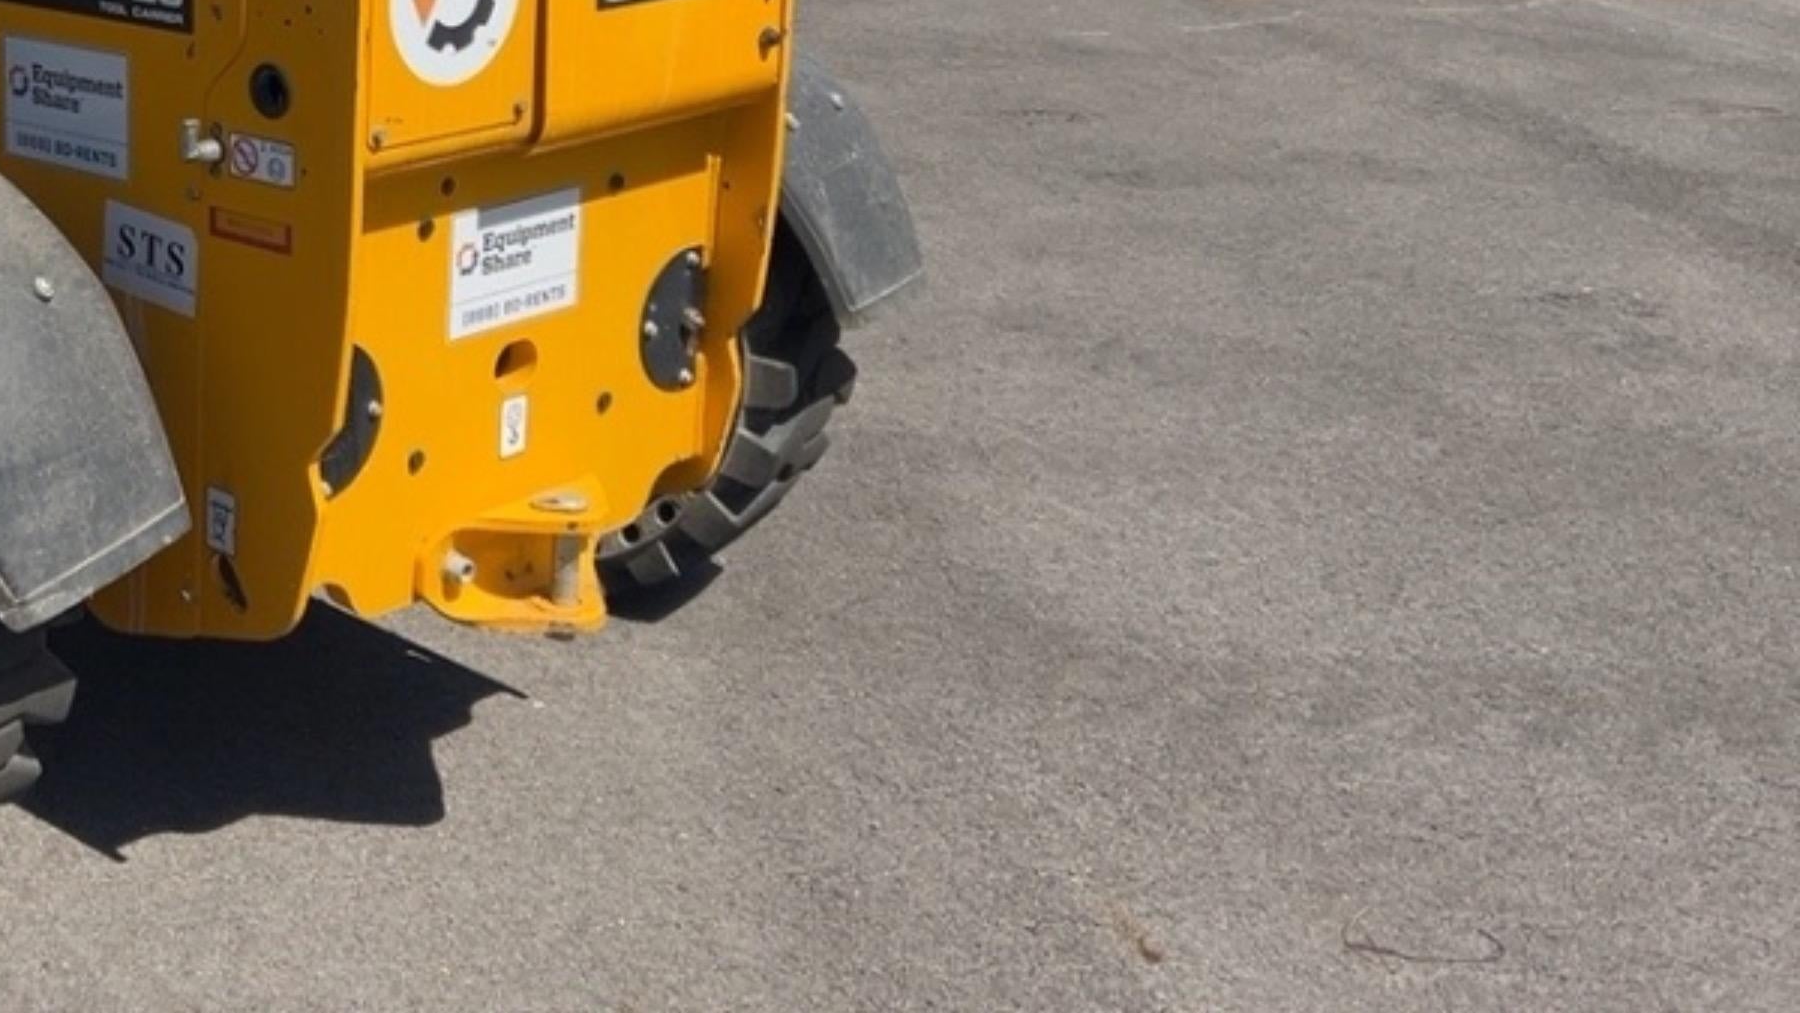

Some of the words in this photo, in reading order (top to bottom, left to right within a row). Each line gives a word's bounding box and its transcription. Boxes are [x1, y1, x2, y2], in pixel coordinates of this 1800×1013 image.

[31, 63, 124, 99] Equipment
[116, 223, 186, 278] STS
[482, 212, 575, 253] Equipment
[482, 249, 533, 276] Share
